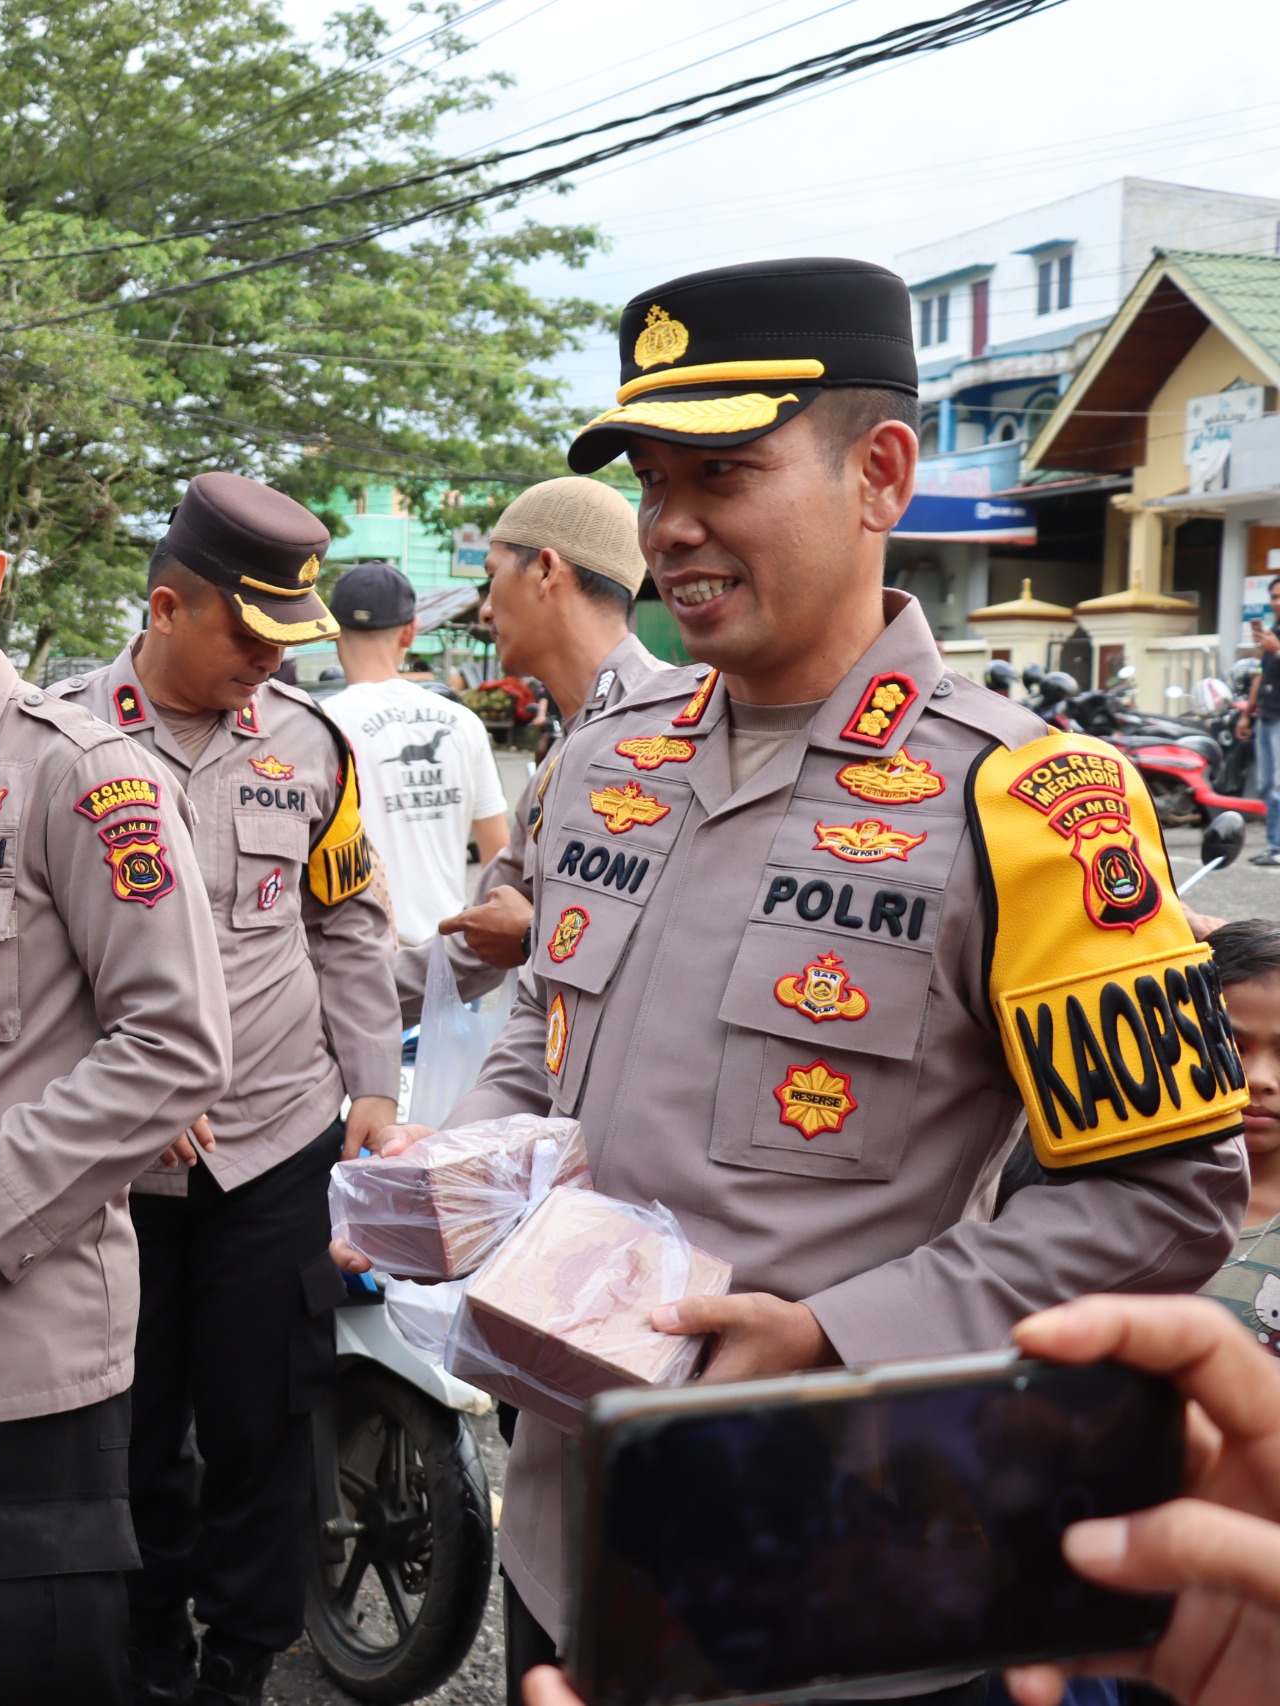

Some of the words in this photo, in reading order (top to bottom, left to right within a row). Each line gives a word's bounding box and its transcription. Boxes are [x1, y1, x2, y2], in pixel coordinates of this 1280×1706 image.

[1017, 754, 1119, 796] POLRES
[1035, 768, 1120, 807] MERANGIN
[89, 780, 150, 805] POLRES
[92, 789, 156, 816] MERANGIN
[239, 785, 306, 812] POLRI
[1063, 799, 1125, 828] JAMBI
[109, 822, 153, 838] JAMBI
[557, 840, 650, 894] RONI
[763, 875, 926, 941] POLRI
[813, 970, 838, 981] SAR
[790, 1089, 842, 1108] RESERSE
